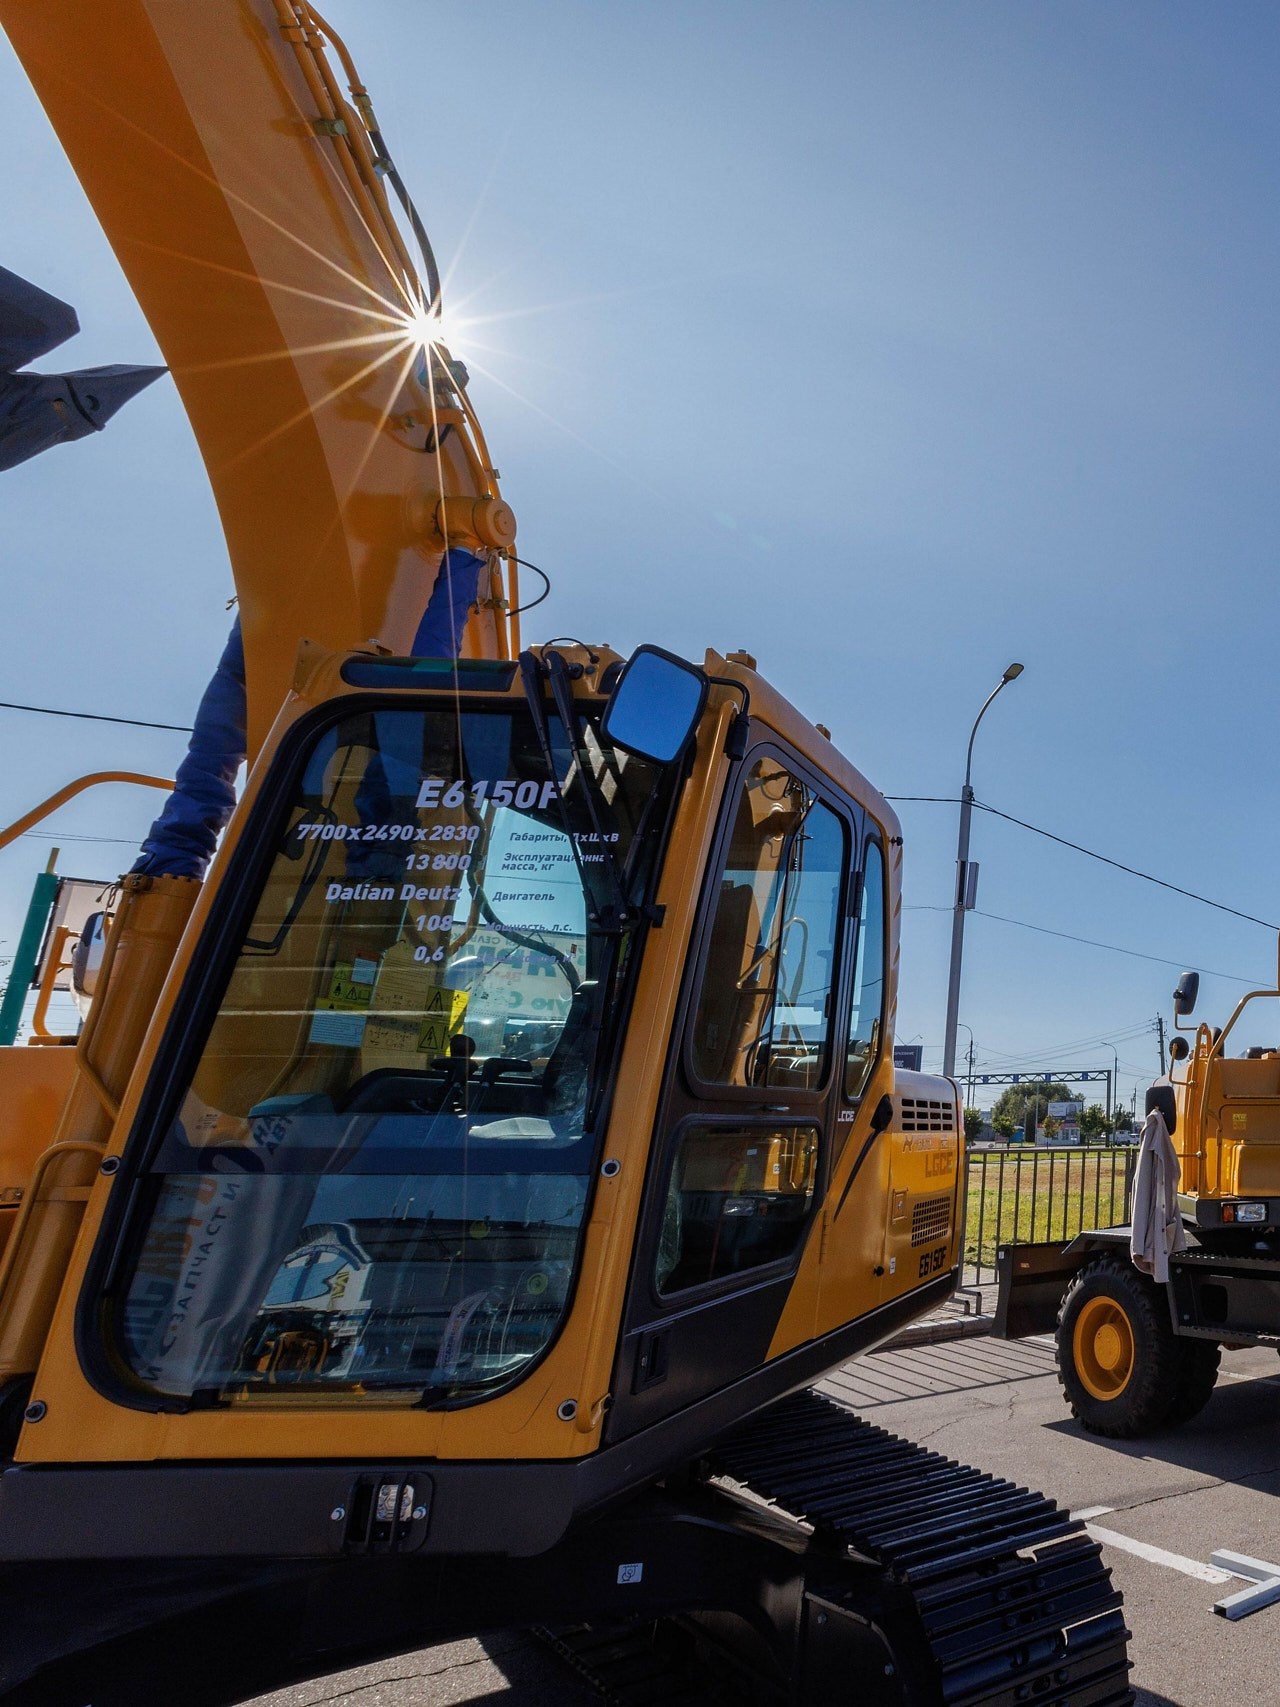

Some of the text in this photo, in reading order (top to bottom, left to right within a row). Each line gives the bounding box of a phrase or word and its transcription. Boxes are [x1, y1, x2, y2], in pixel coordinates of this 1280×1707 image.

[415, 780, 565, 808] E6150F
[509, 832, 568, 843] Габариты,
[501, 863, 554, 871] масса, кг
[326, 884, 462, 901] Dalian Deutz
[492, 891, 555, 901] Двигатель
[416, 915, 452, 931] 108
[414, 946, 443, 964] 0,6
